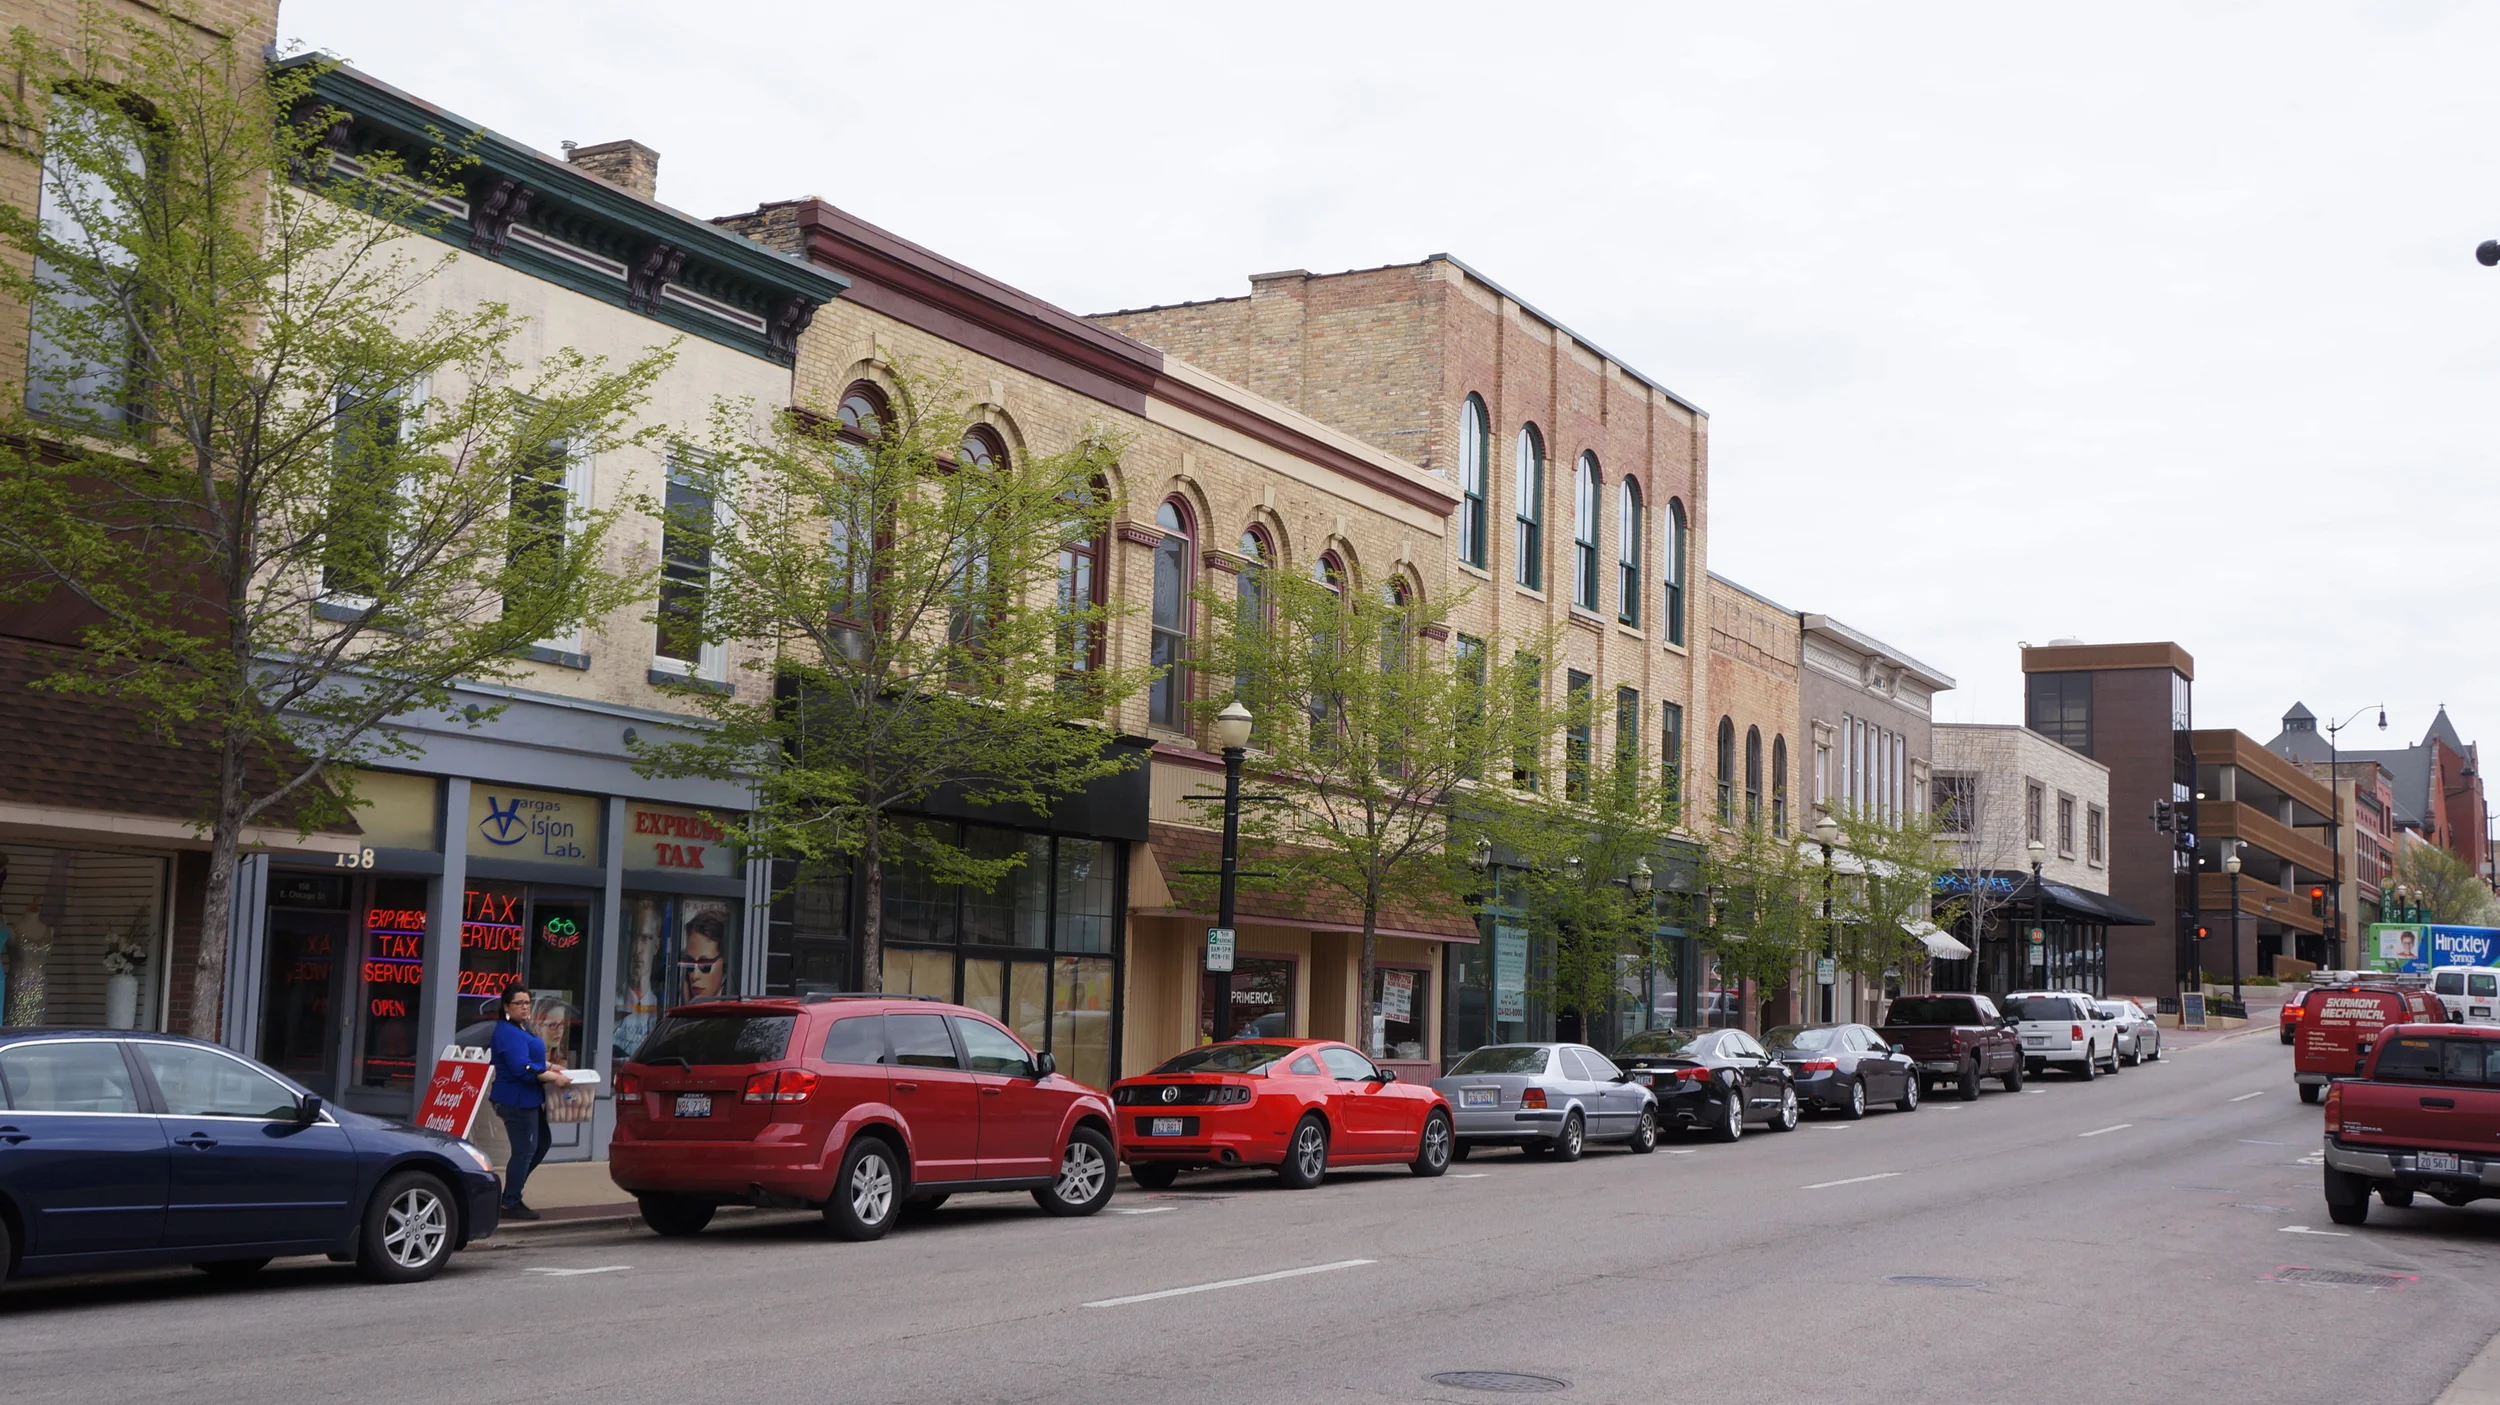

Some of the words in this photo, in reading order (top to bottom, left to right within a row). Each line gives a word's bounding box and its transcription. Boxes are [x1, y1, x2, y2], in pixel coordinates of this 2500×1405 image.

[635, 812, 726, 841] EXPRESS
[335, 848, 375, 869] 158
[655, 843, 705, 869] TAX
[464, 891, 517, 923] TAX
[379, 935, 419, 957] TAX
[461, 924, 524, 951] ERVICE
[542, 925, 558, 947] EYE
[557, 931, 580, 949] CARE
[1210, 931, 1217, 943] 2
[2435, 933, 2490, 959] Hinckley
[1210, 945, 1232, 953] 8AM-5PM
[2449, 951, 2476, 966] Springs
[364, 963, 424, 985] SERVIC
[371, 999, 406, 1017] OPEN
[1230, 991, 1274, 1004] PRIMERICA
[2320, 1008, 2386, 1020] MECHANICAL
[450, 1065, 466, 1084] We
[432, 1089, 463, 1112] Accept
[424, 1113, 455, 1132] Outside
[2433, 1158, 2448, 1168] 567
